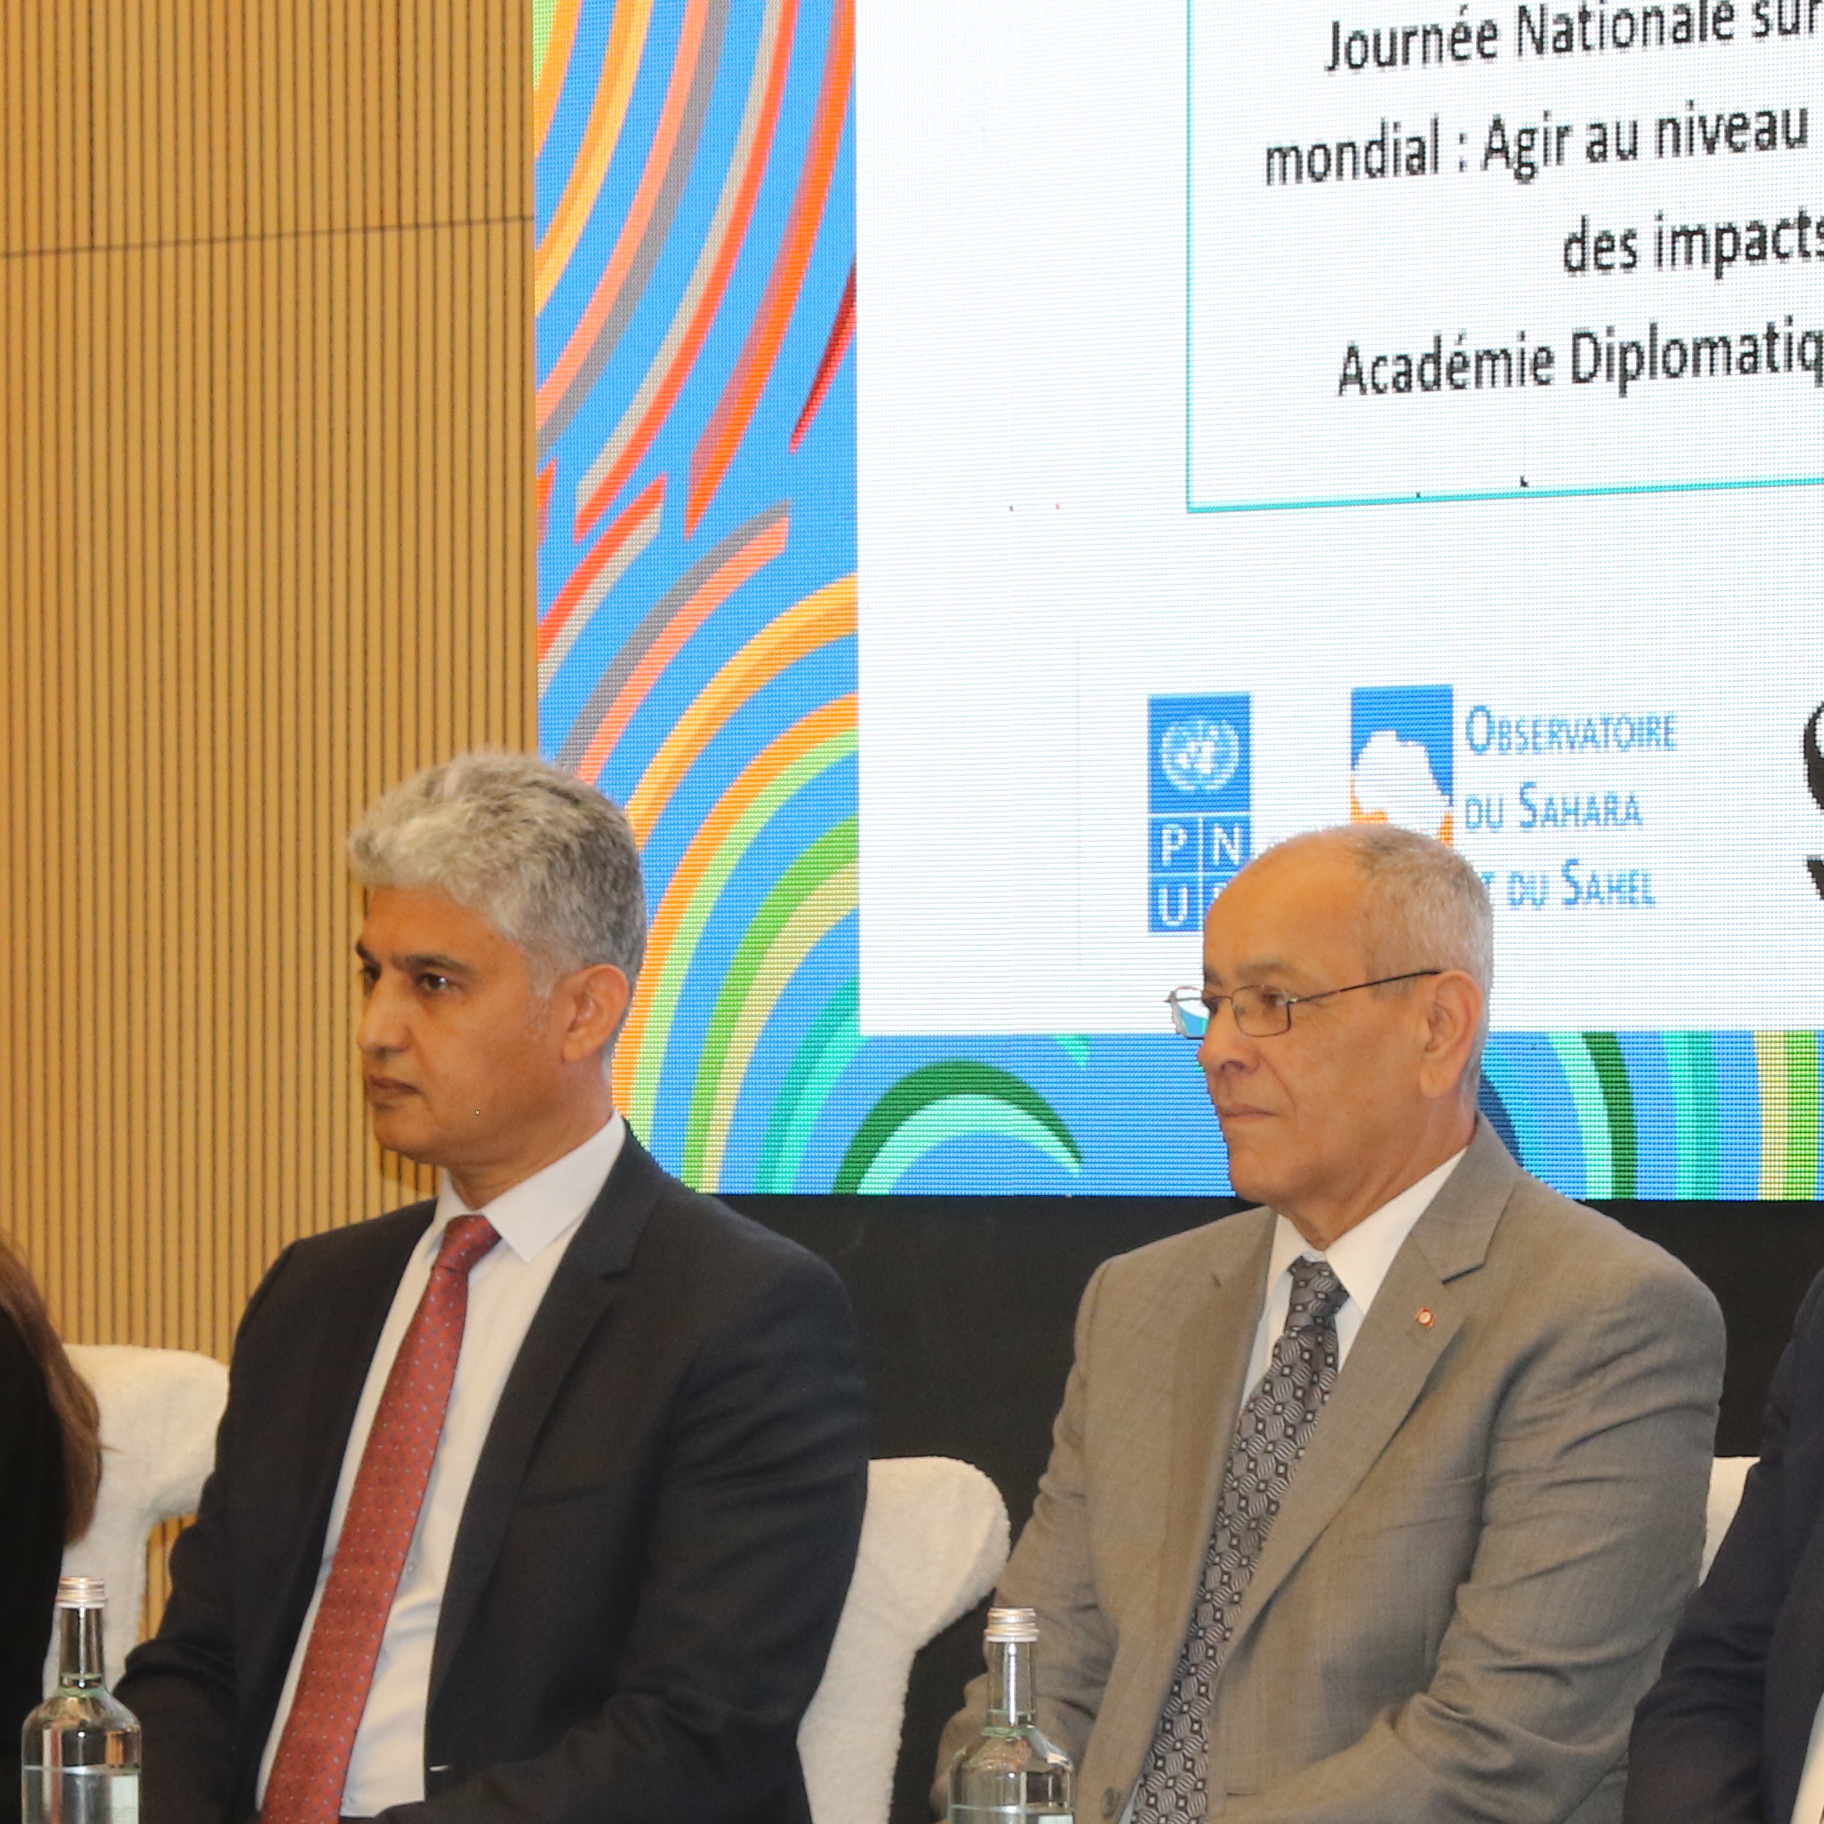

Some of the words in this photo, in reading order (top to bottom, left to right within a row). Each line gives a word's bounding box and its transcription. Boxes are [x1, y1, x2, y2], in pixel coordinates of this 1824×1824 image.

[1325, 4, 1500, 73] Journée
[1516, 0, 1736, 57] Nationale
[1751, 0, 1824, 40] sur
[1265, 115, 1440, 186] mondial
[1481, 110, 1572, 185] Agir
[1584, 120, 1639, 165] au
[1656, 99, 1809, 158] niveau
[1562, 215, 1639, 275] des
[1337, 331, 1556, 398] Académie
